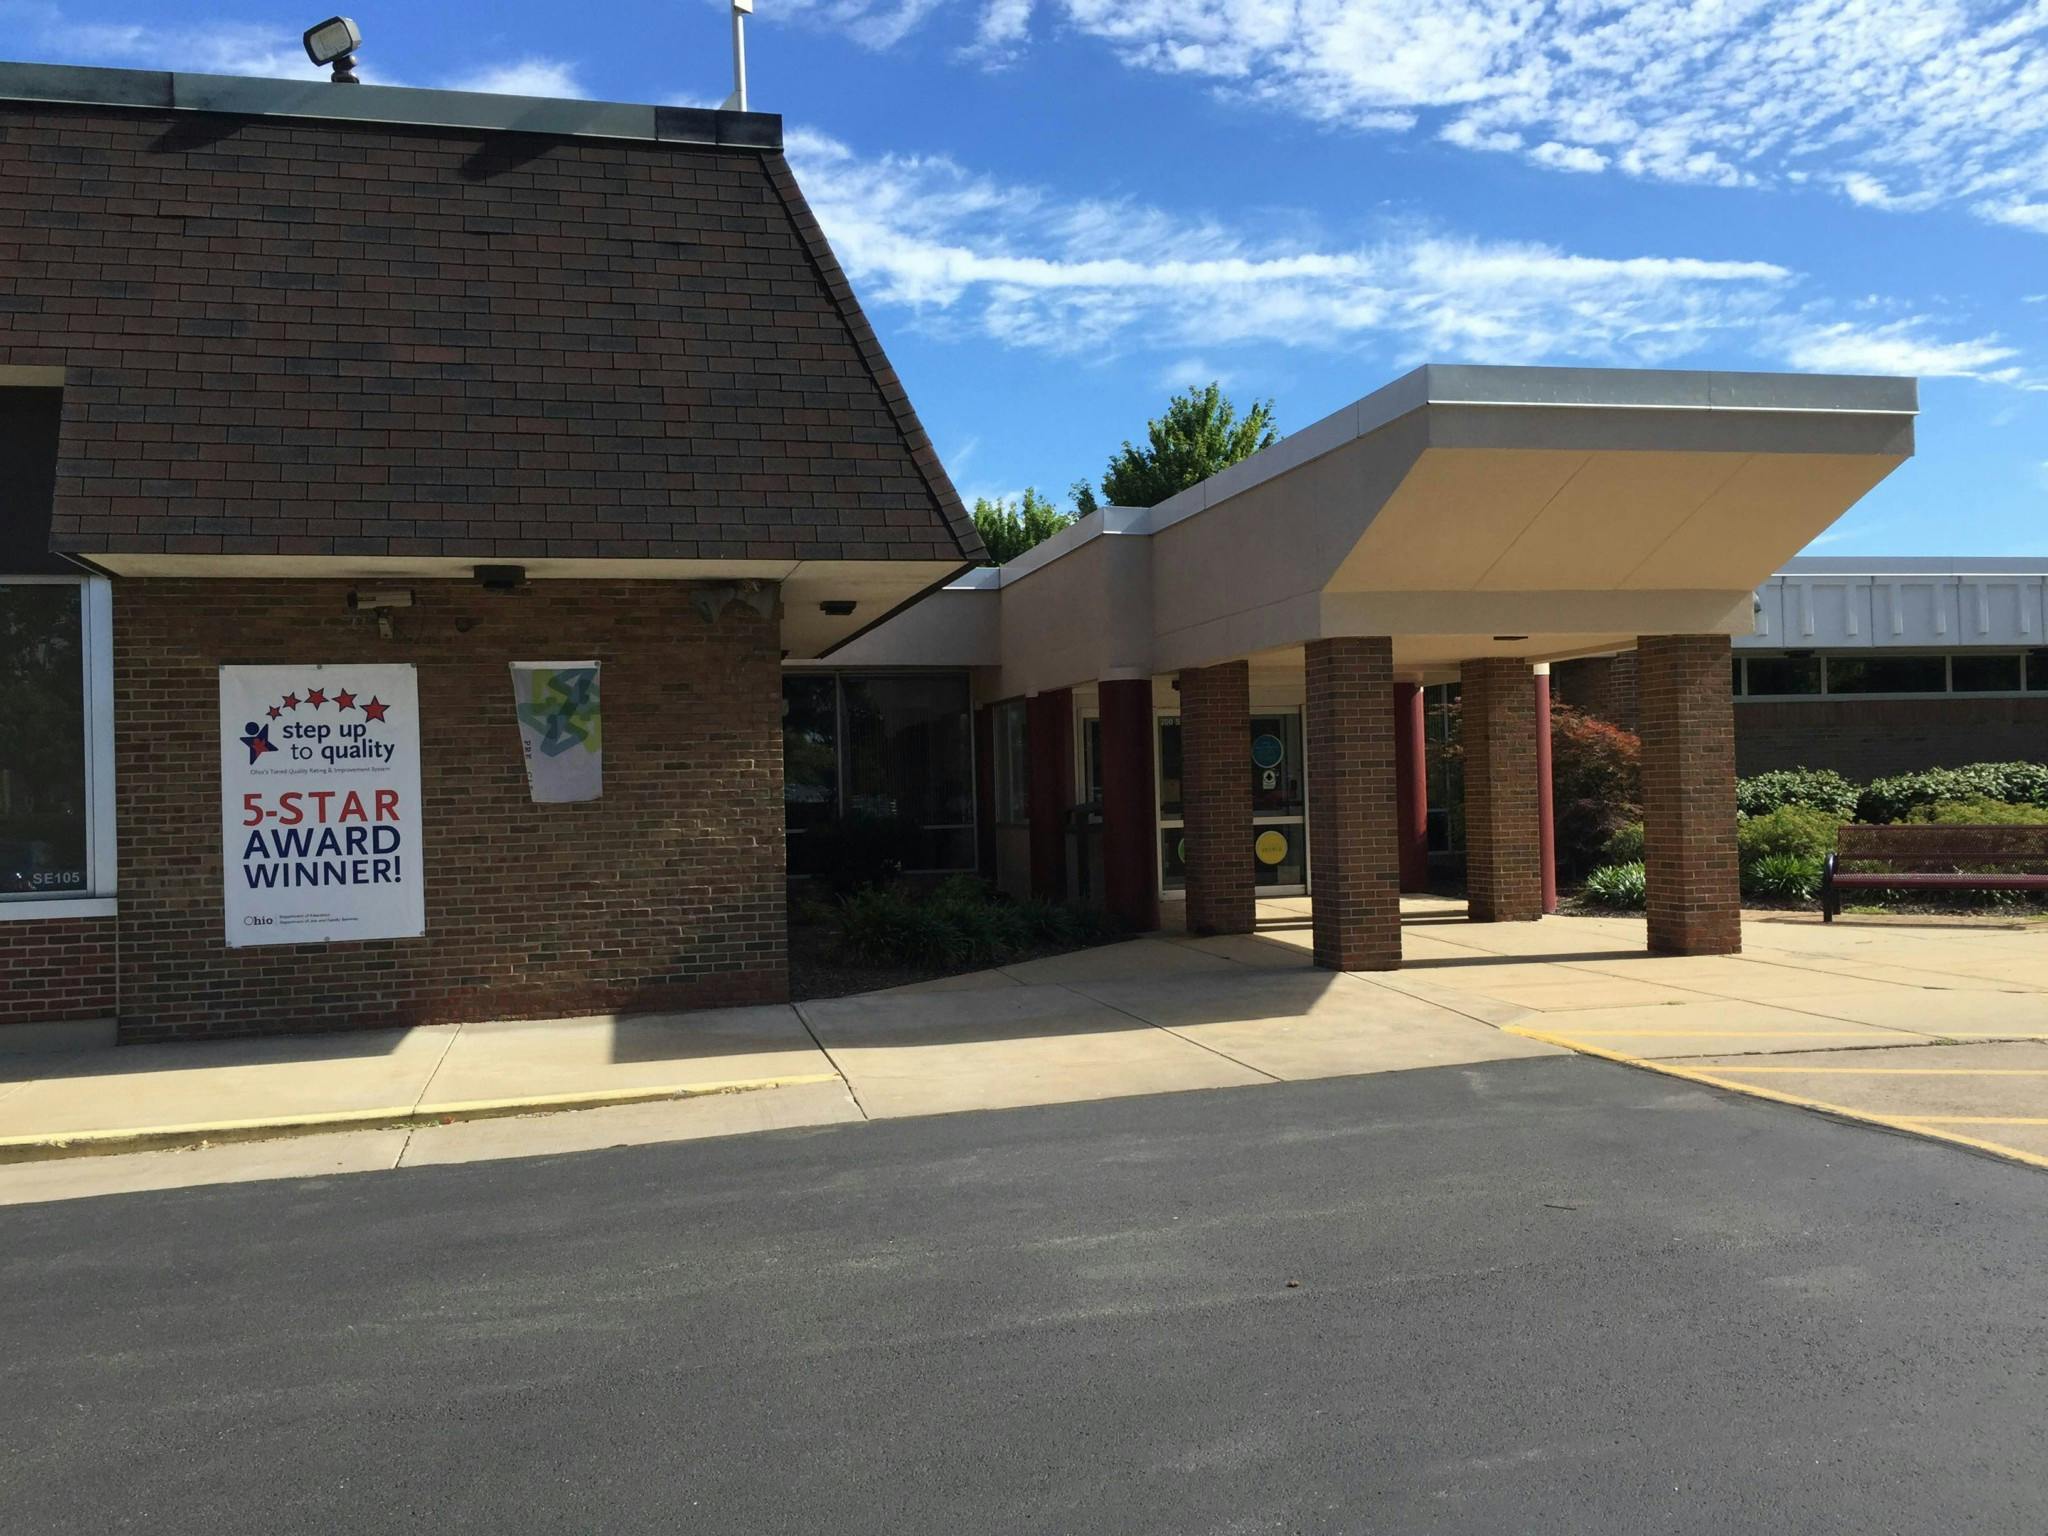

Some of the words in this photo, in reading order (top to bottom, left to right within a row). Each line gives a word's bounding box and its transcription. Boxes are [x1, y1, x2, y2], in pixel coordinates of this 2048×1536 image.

[282, 721, 331, 744] step
[339, 723, 367, 743] up
[291, 743, 313, 760] to
[321, 739, 395, 765] quality
[243, 789, 401, 827] 5-STAR
[242, 825, 401, 859] AWARD
[32, 871, 80, 884] SE105
[243, 856, 402, 889] WINNER!
[244, 915, 274, 926] Ohio
